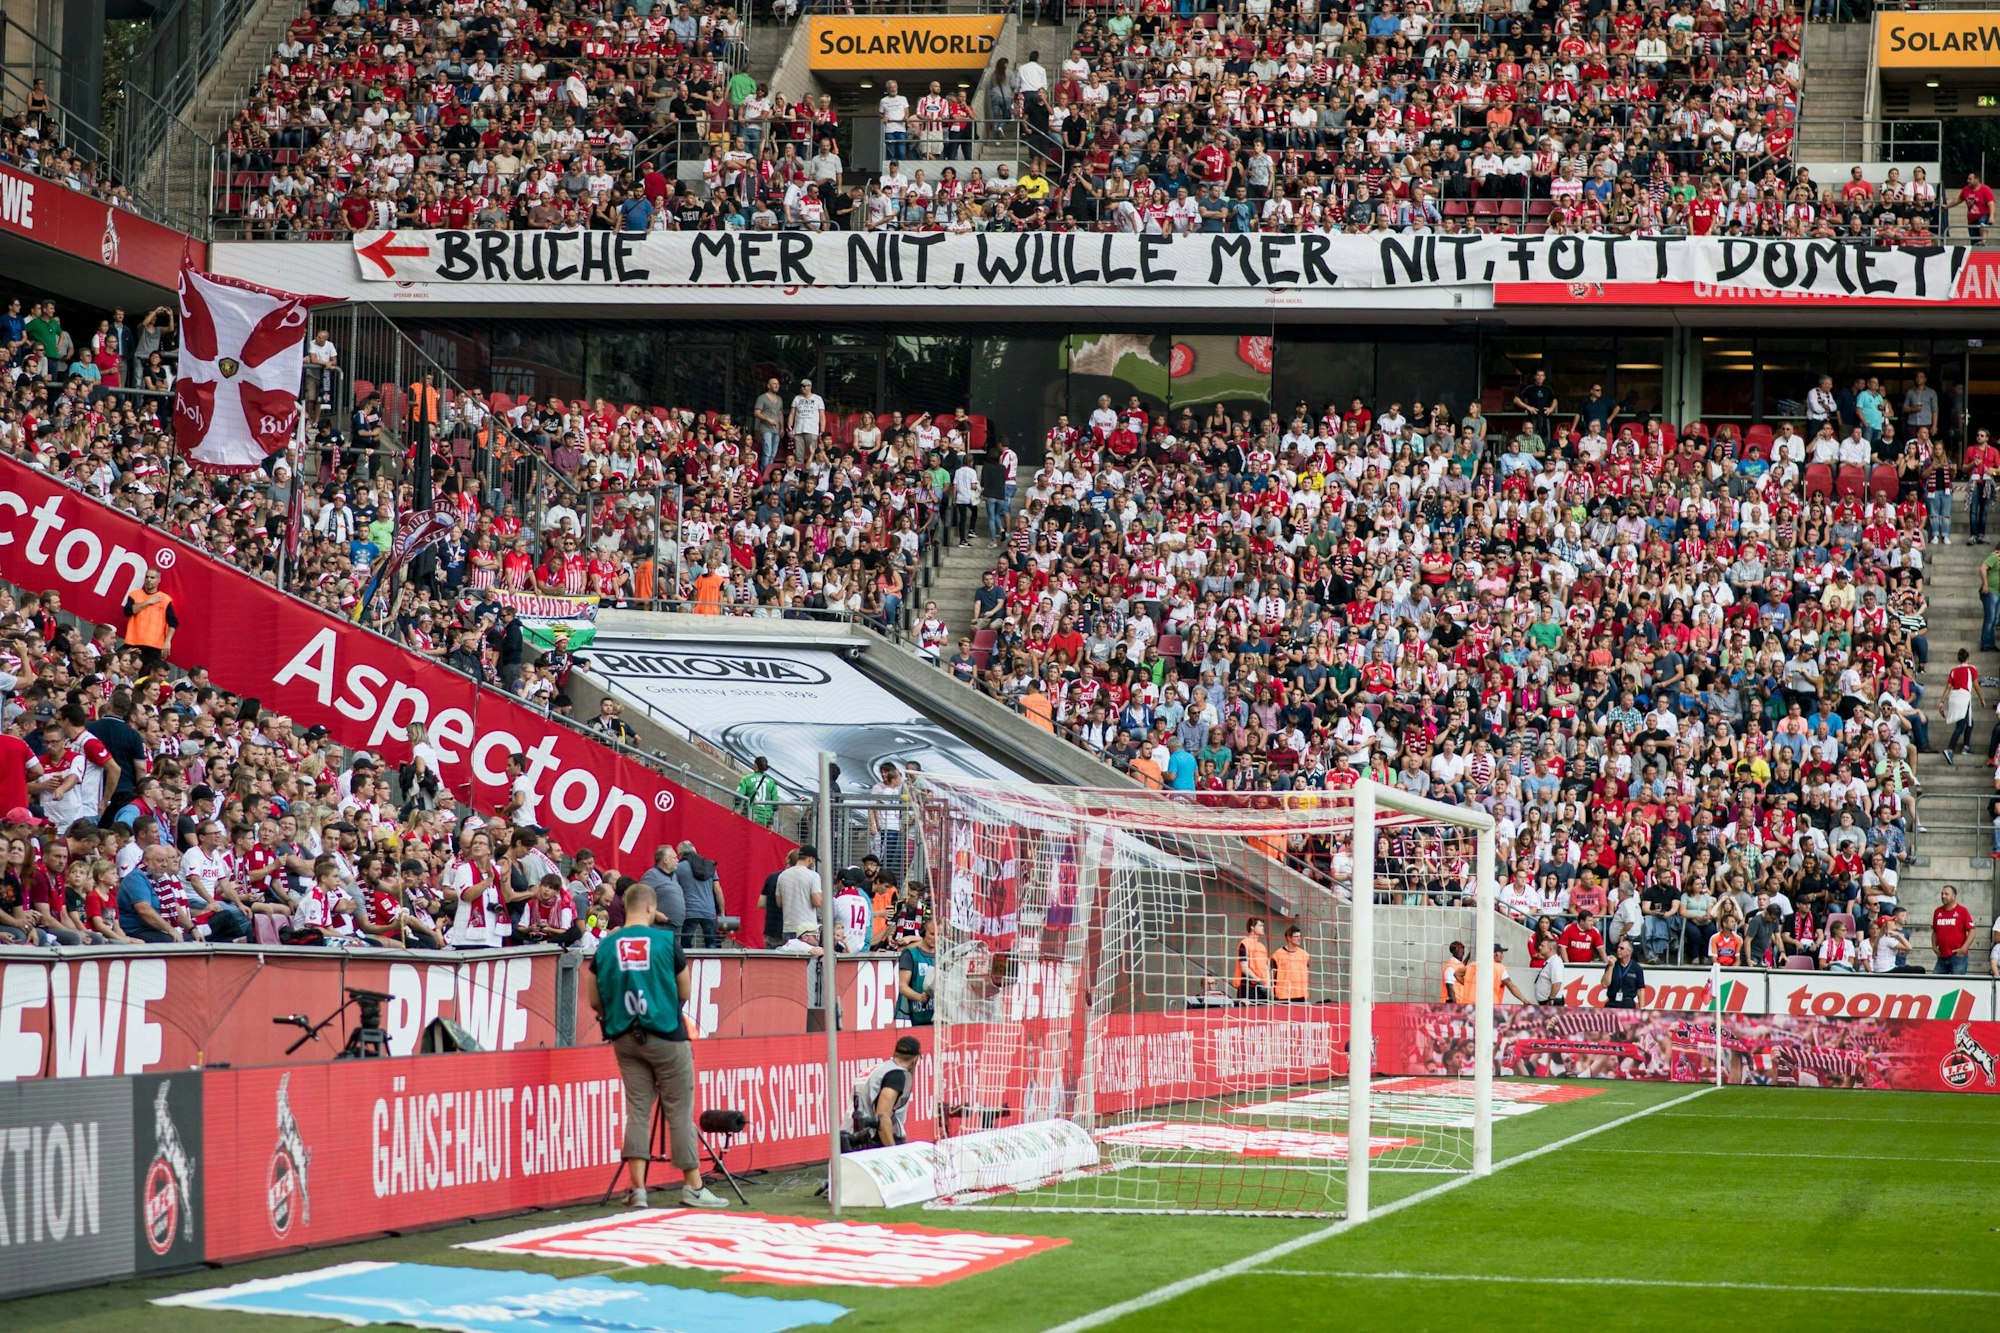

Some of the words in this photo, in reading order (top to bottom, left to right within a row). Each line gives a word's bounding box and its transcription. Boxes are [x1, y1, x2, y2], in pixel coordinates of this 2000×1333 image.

[0, 173, 34, 229] WE
[435, 230, 650, 283] BRUCHE
[689, 231, 816, 285] MER
[977, 233, 1177, 285] WULLE
[1208, 234, 1338, 286] MER
[645, 685, 727, 698] Germany
[730, 688, 774, 698] since
[779, 690, 818, 700] 1898
[850, 904, 867, 931] 14
[1936, 918, 1956, 926] REWE
[1570, 940, 1591, 949] REWE
[387, 957, 532, 1057] REWE
[624, 989, 648, 1016] 06
[1788, 983, 1932, 1018] toom
[1943, 1062, 1972, 1075] 1.FC
[1949, 1072, 1968, 1083] KÖLN
[372, 1076, 514, 1199] GÄNSEHAUT
[520, 1078, 627, 1177] GARANTIE
[699, 1066, 767, 1148] TICKETS
